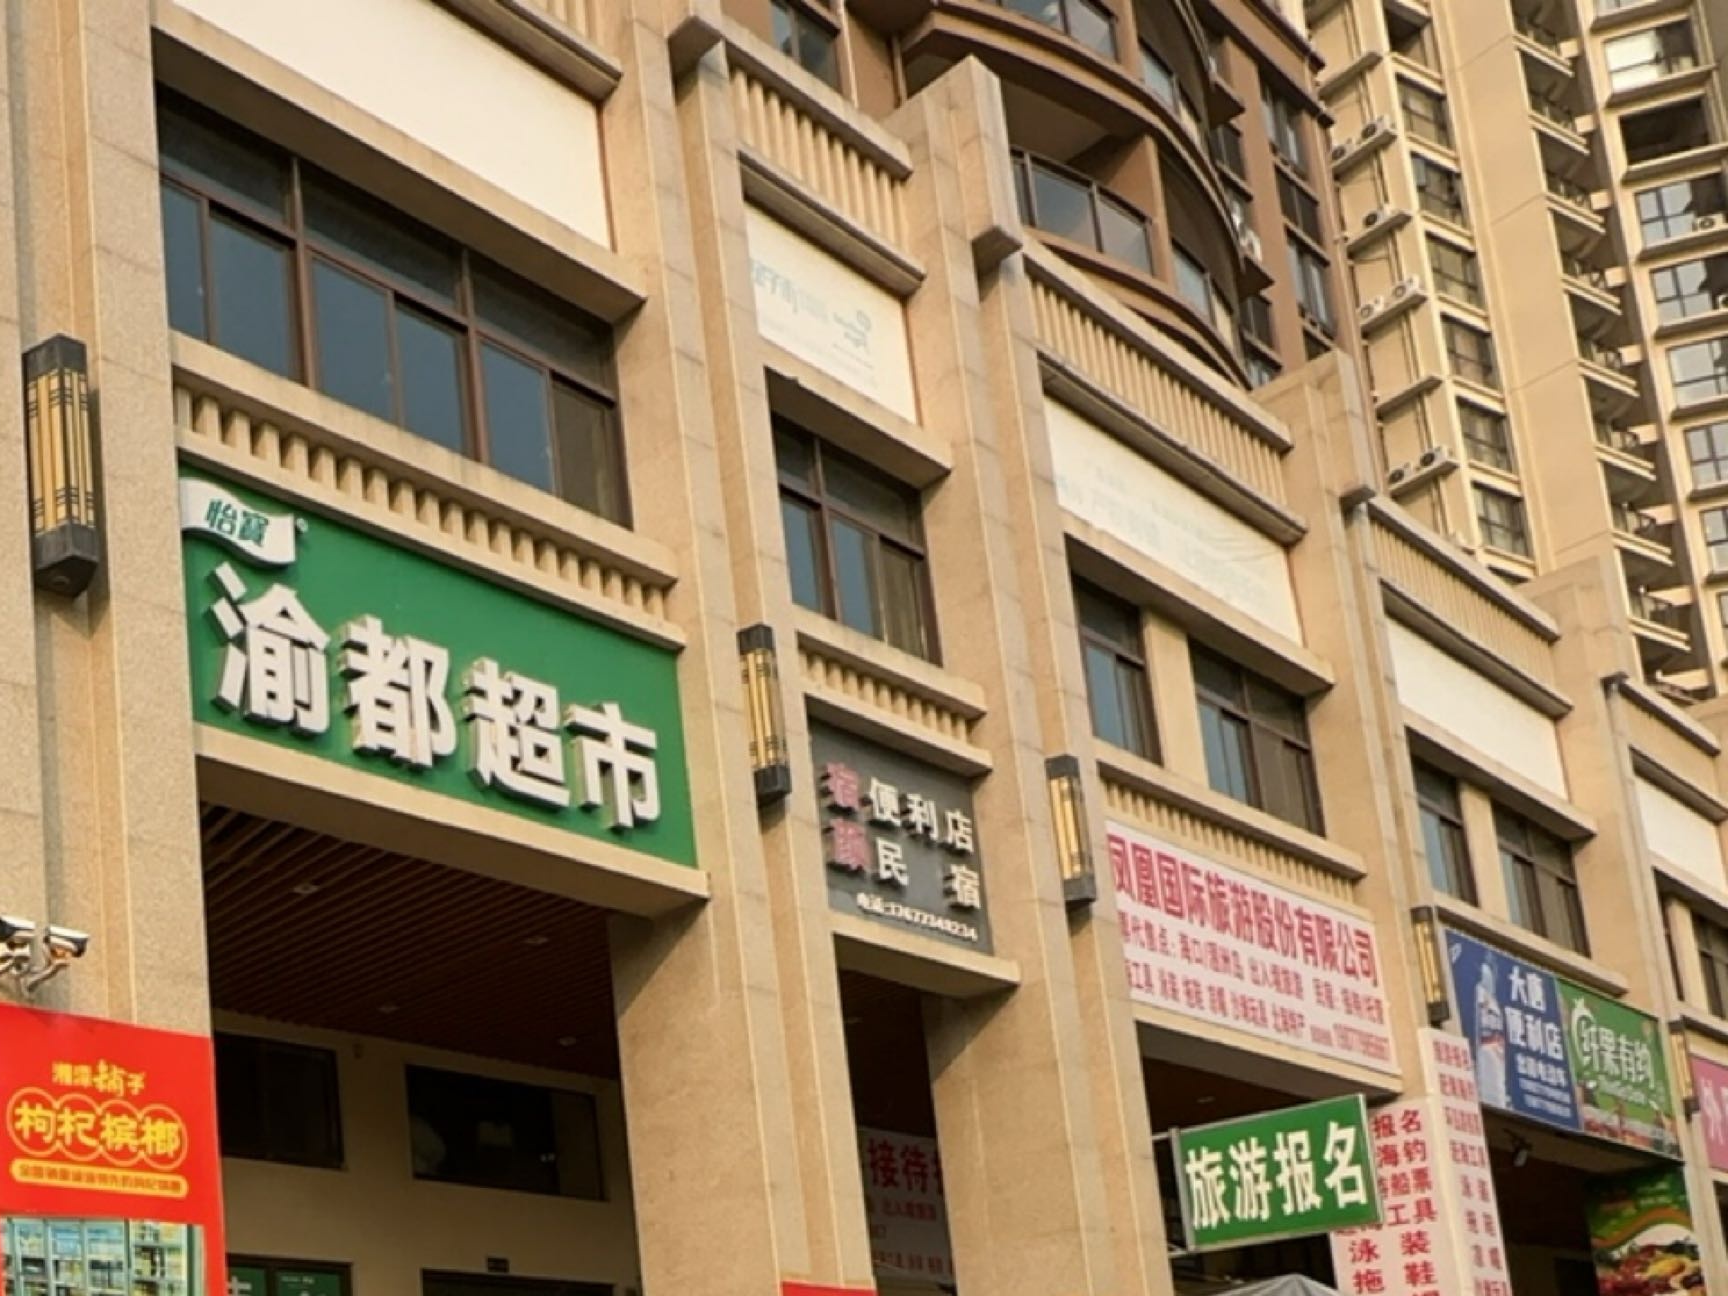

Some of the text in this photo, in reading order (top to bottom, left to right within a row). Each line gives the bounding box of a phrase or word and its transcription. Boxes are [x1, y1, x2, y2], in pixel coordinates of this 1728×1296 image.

[210, 561, 661, 831] 渝都超市
[869, 776, 975, 855] 便利店
[14, 1100, 182, 1158] 枸杞槟榔
[1184, 1118, 1370, 1225] 旅游报名
